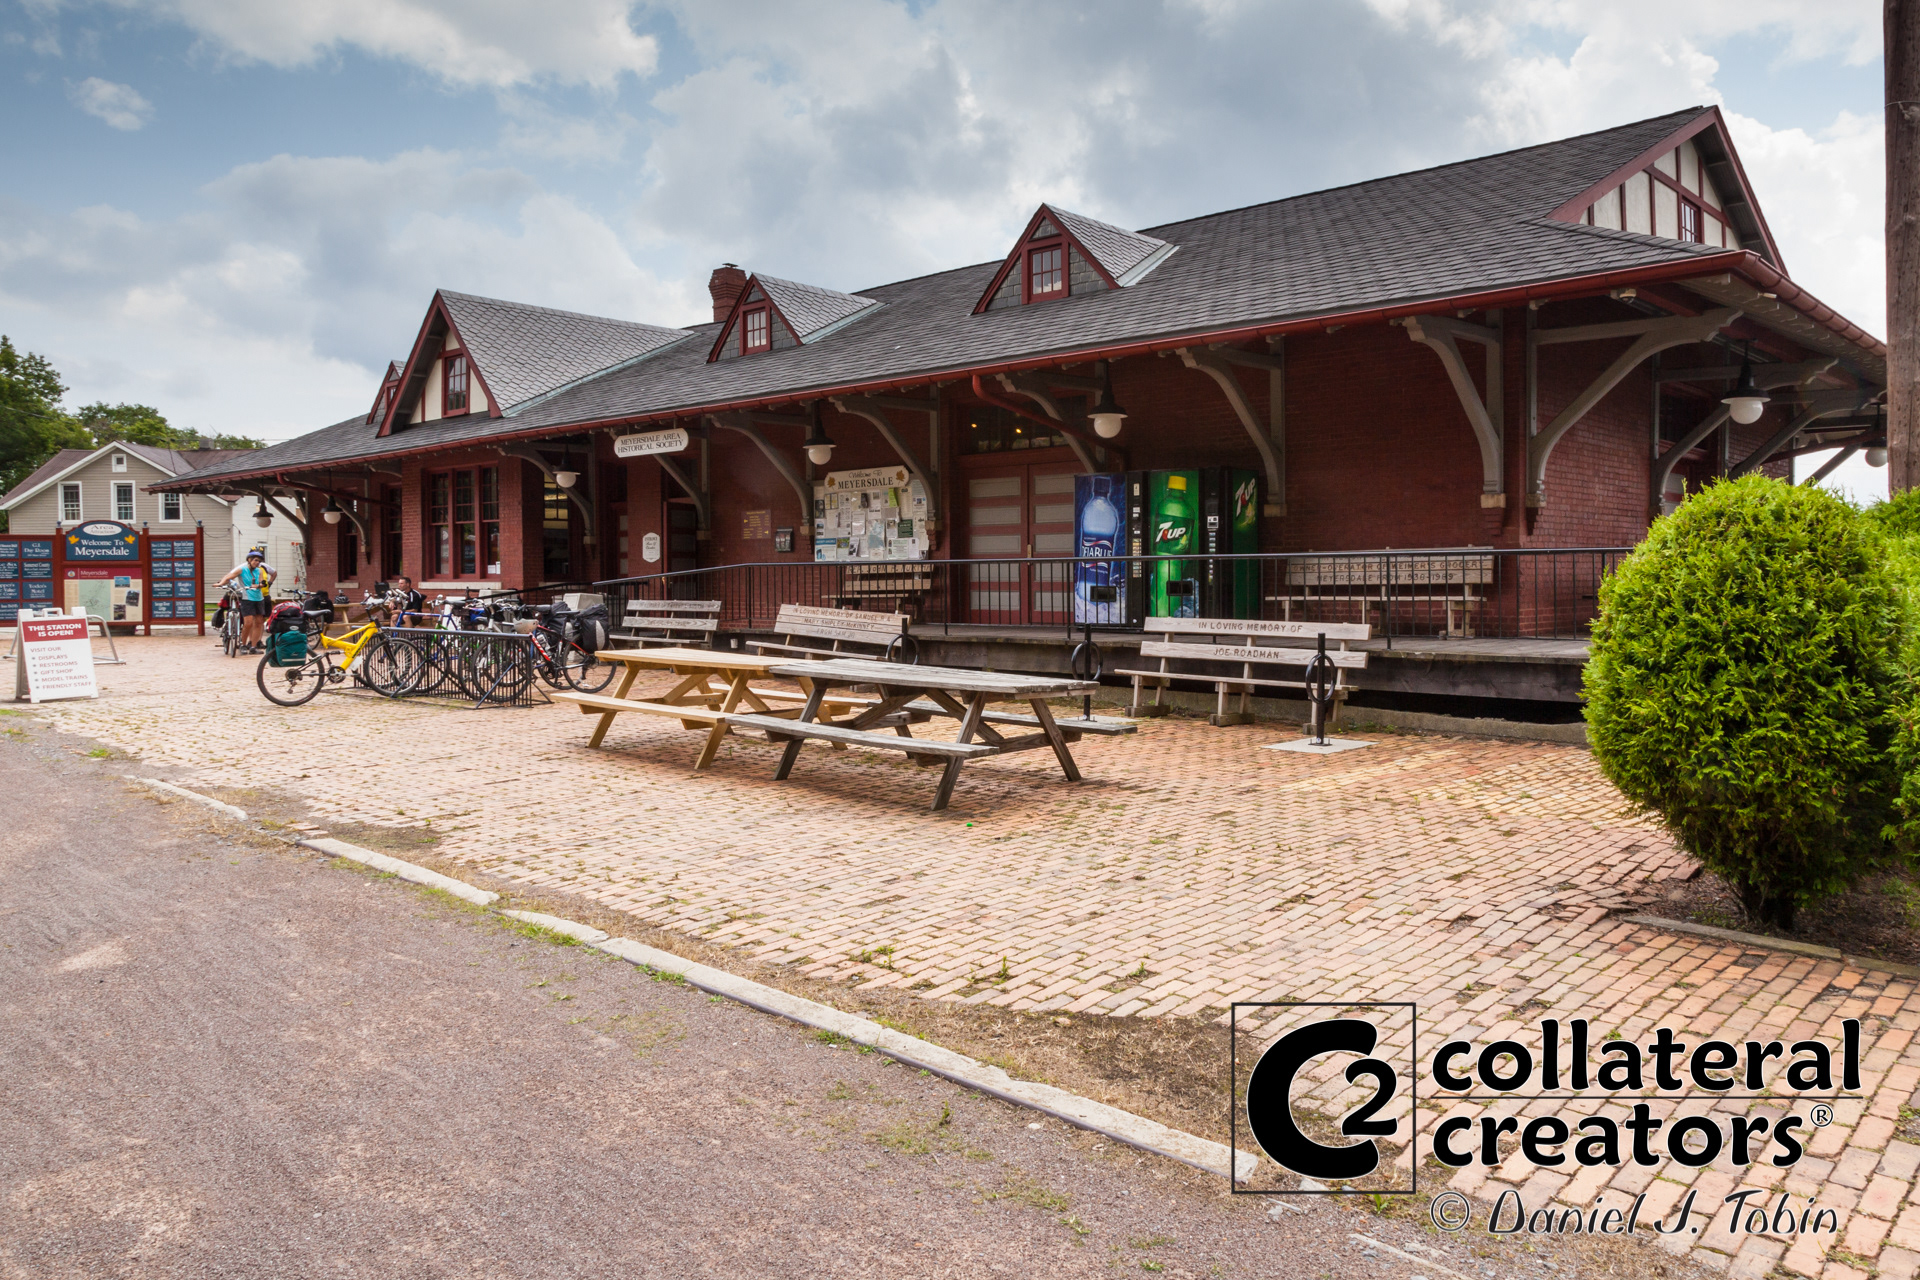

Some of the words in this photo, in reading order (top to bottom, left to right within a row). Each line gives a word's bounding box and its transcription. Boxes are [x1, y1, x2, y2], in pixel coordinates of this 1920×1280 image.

[621, 435, 660, 445] MEYERSDALE
[618, 444, 654, 453] HISTORICAL
[656, 440, 683, 448] SOCIETY
[838, 477, 893, 489] MEYERSDALE
[1156, 521, 1186, 542] 7UP
[75, 547, 129, 557] Meyersdale
[1210, 622, 1243, 630] LOVING
[1247, 624, 1286, 632] MEMORY
[1214, 648, 1230, 656] JOE
[1234, 649, 1280, 659] ROADMAN
